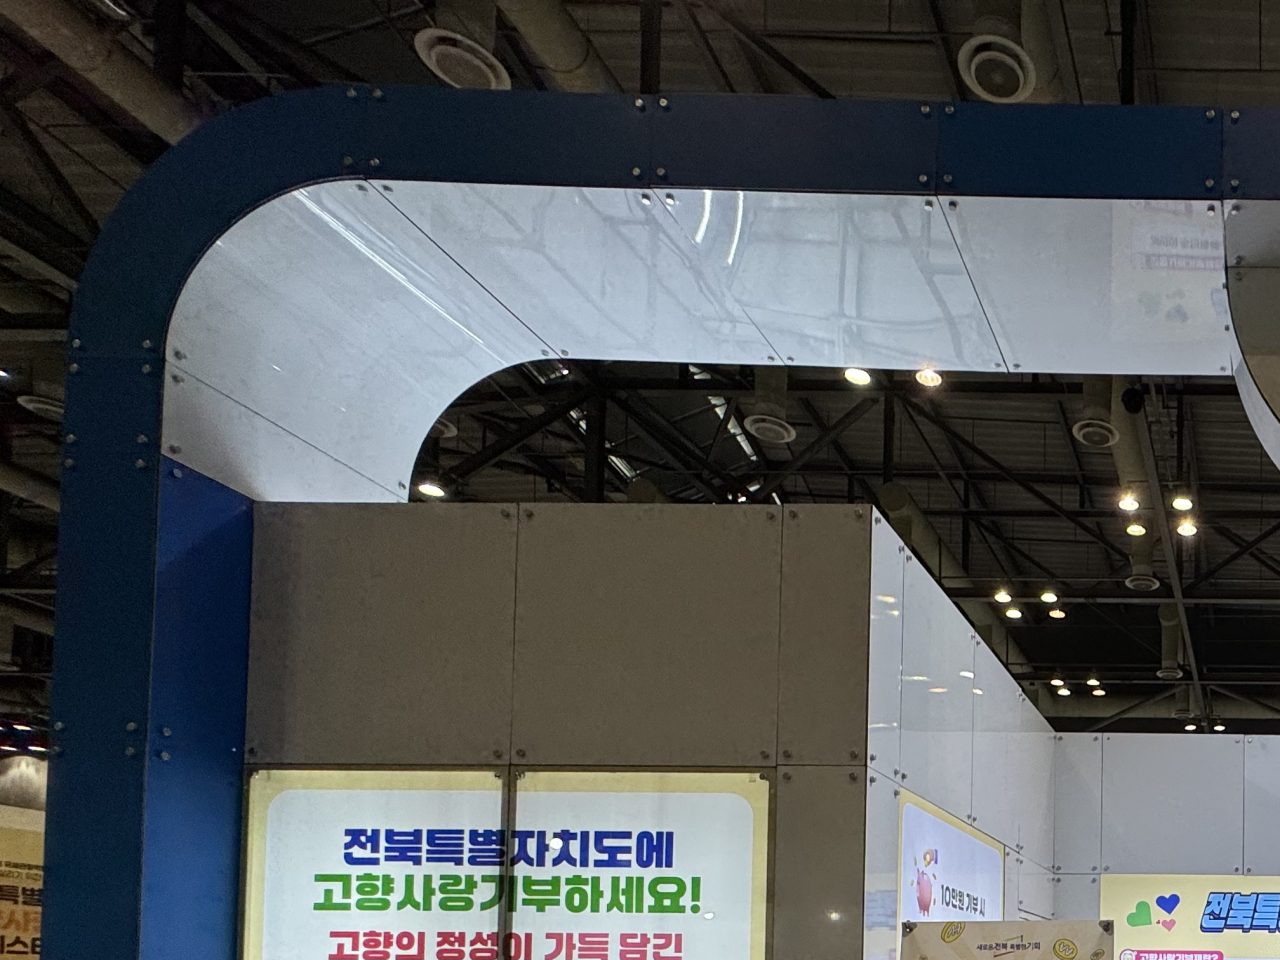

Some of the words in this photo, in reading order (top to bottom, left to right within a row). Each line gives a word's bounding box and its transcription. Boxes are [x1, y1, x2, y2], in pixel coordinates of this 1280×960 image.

[343, 828, 674, 869] 전북특별자치도에
[312, 874, 701, 914] 고향사랑기부하세요!
[328, 931, 425, 960] 고향의
